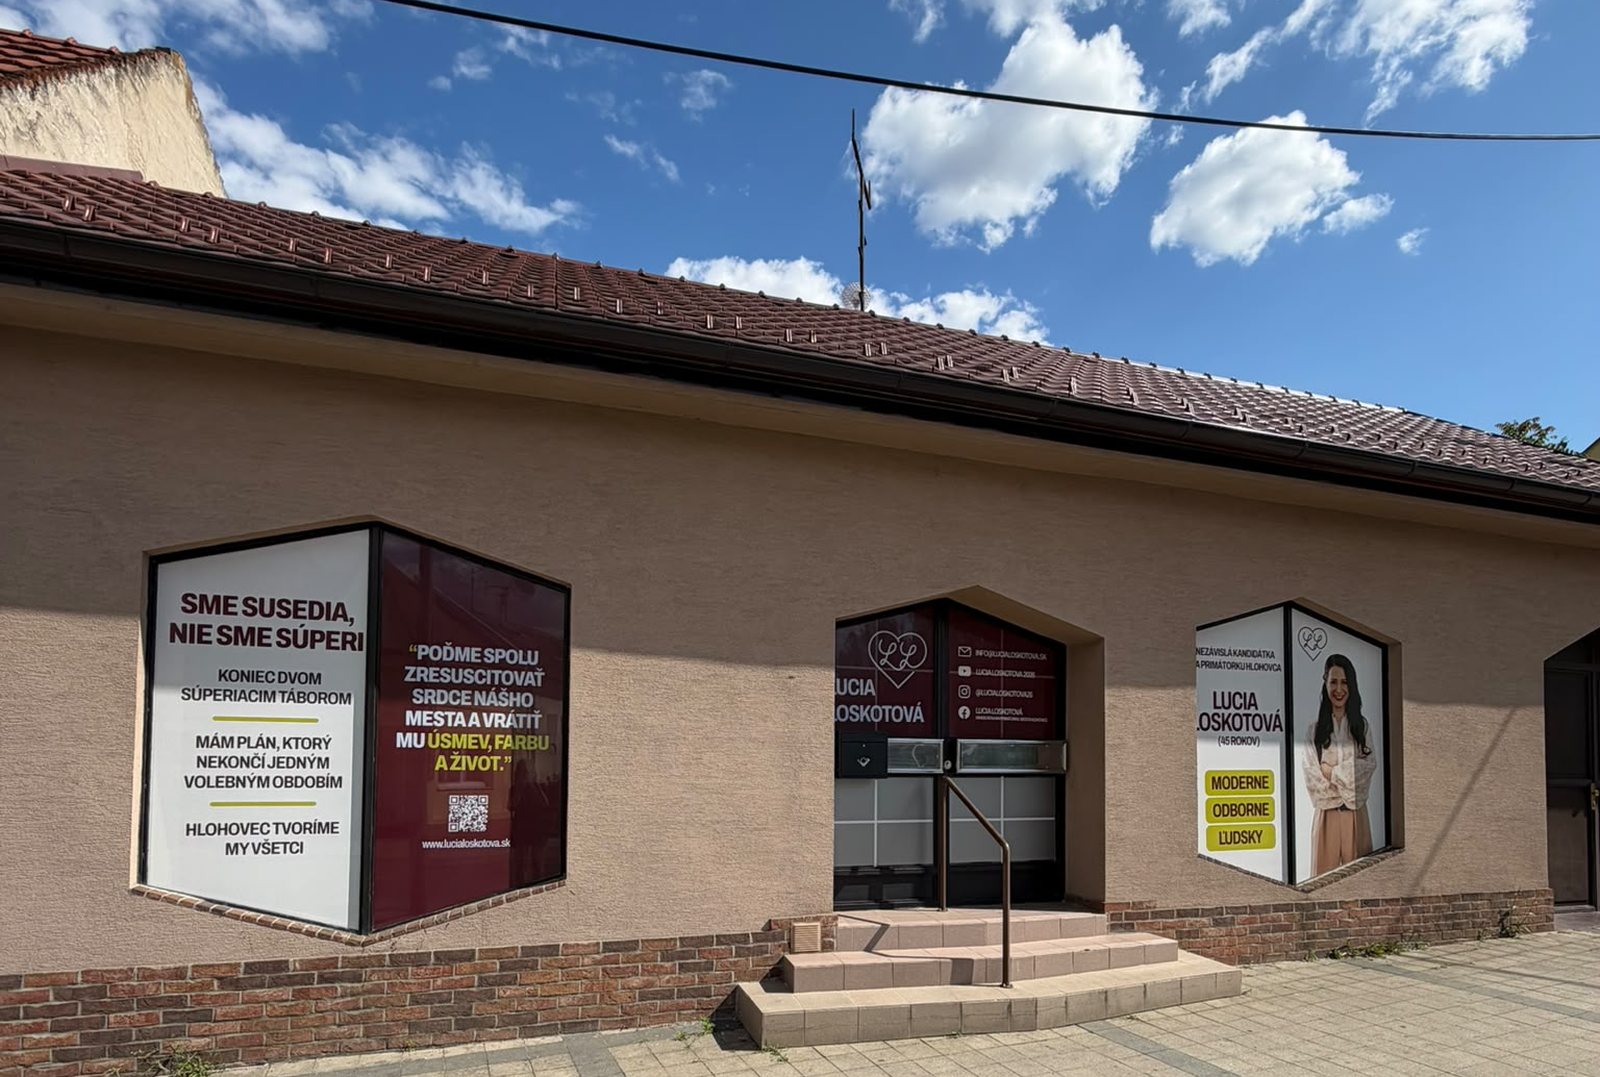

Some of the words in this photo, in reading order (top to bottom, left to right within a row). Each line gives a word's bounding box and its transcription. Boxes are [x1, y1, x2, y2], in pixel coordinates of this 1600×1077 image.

[180, 592, 239, 616] SME
[242, 596, 355, 627] SUSEDIA,
[169, 622, 212, 645] NIE
[216, 625, 273, 648] SME
[276, 624, 364, 652] SÚPERI
[483, 649, 539, 666] SPOLU
[1195, 646, 1233, 657] NEZÁVISLÁ
[1233, 647, 1275, 659] KANDIDÁTKA
[1245, 661, 1282, 672] HLOHOVCA
[218, 669, 275, 684] KONIEC
[278, 671, 322, 685] DVOM
[404, 666, 545, 687] ZRESUSCITOVAŤ
[181, 685, 276, 703] SÚPERIACIM
[279, 688, 352, 705] TÁBOROM
[834, 677, 876, 697] UCIA
[412, 689, 472, 706] SRDCE
[474, 687, 534, 708] NÁŠHO
[1213, 691, 1258, 710] LUCIA
[405, 710, 466, 727] MESTA
[467, 712, 481, 728] A
[482, 710, 543, 729] VRÁTIŤ
[834, 701, 926, 723] OSKOTOVÁ
[1196, 708, 1283, 732] OSKOTOVÁ
[195, 732, 234, 749] MÁM
[237, 733, 280, 752] PLÁN,
[282, 734, 332, 750] KTORÝ
[395, 732, 425, 749] MU
[427, 729, 492, 753] ÚSMEV,
[494, 735, 550, 750] FARBU
[1230, 736, 1261, 747] ROKOV)
[196, 752, 265, 769] NEKONČÍ
[267, 753, 330, 769] JEDNÝM
[434, 754, 448, 771] A
[184, 773, 270, 789] VOLEBNÝM
[272, 773, 343, 789] OBDOBÍM
[1211, 775, 1269, 790] MODERNE
[1213, 802, 1270, 818] ODBORNE
[185, 822, 270, 836] HLOHOVEC
[272, 819, 340, 835] TVORÍME
[225, 842, 250, 855] MY
[251, 839, 304, 855] VŠETCI
[421, 838, 511, 849] www.lucialoskotova.sk
